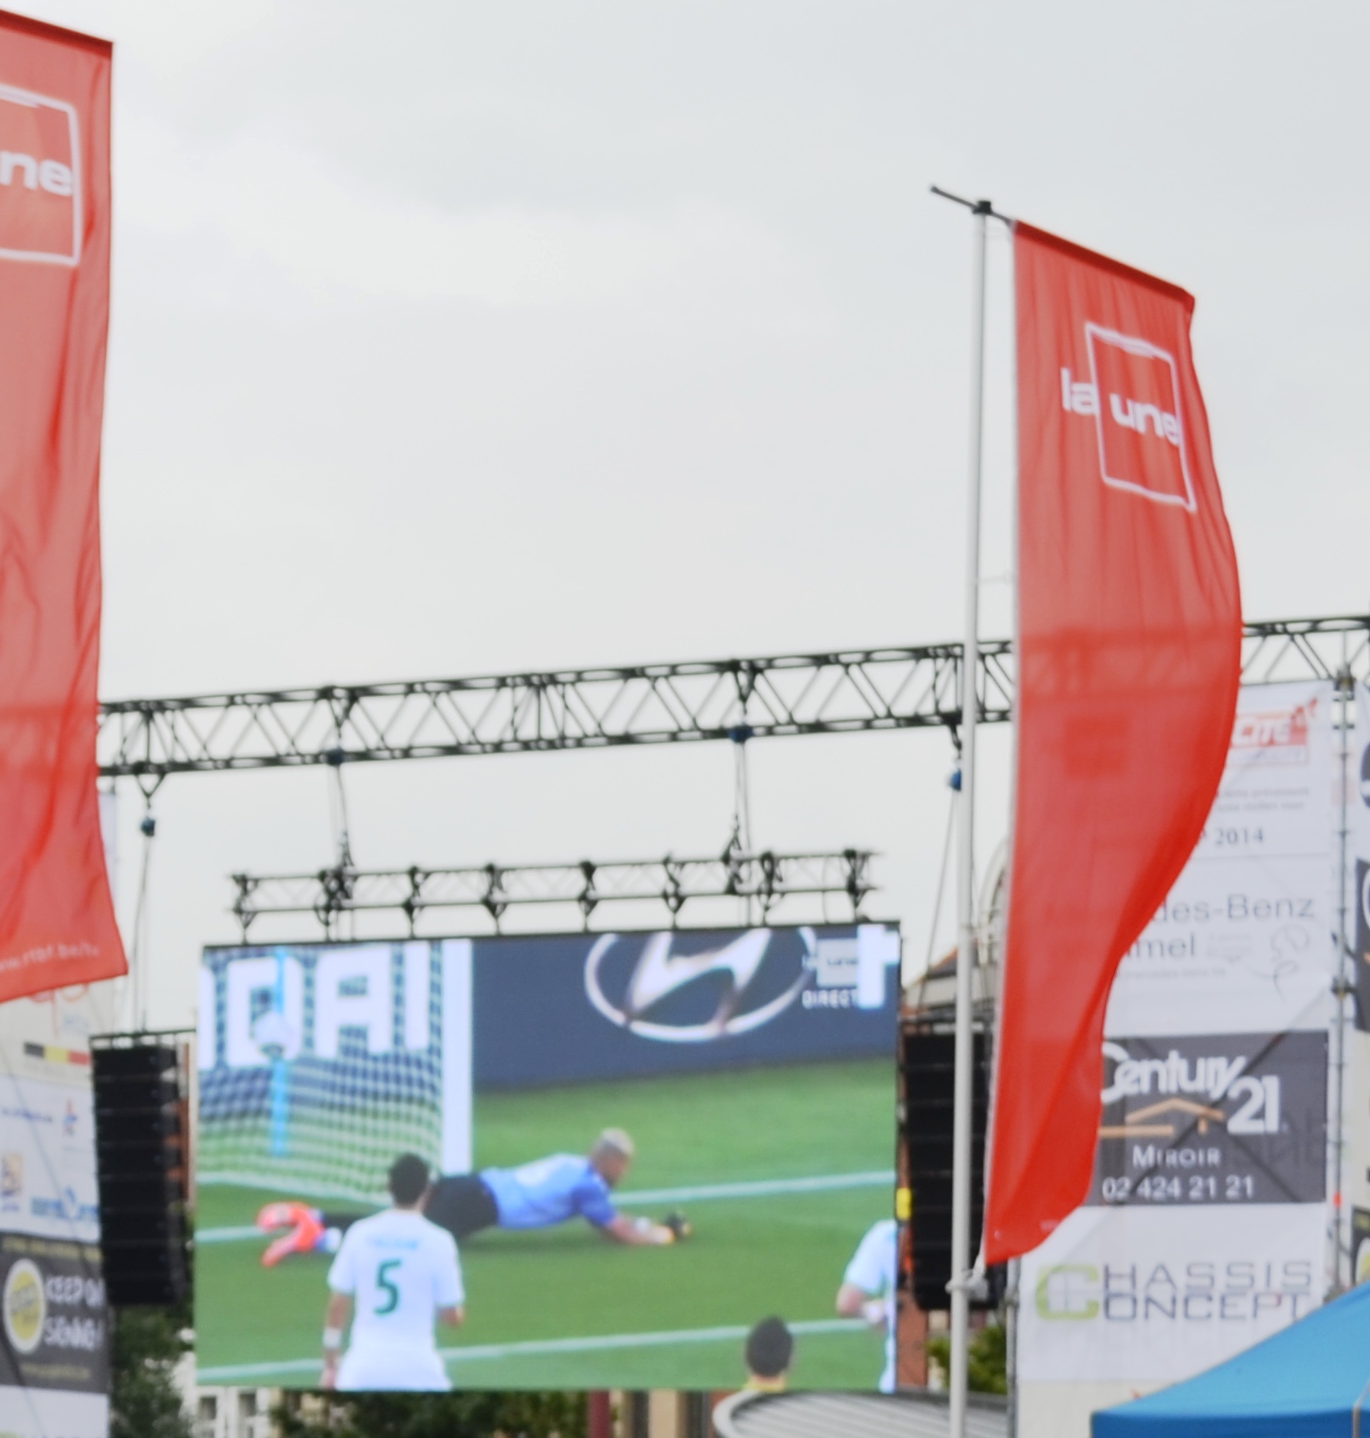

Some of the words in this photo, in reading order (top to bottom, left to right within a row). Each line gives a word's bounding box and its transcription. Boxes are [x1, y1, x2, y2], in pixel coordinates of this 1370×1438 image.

[1061, 366, 1098, 415] la
[1110, 393, 1181, 447] une
[1215, 827, 1265, 846] 2014
[1101, 1040, 1248, 1104] Century
[1226, 1075, 1281, 1134] 21
[1102, 1176, 1131, 1202] 02
[1136, 1176, 1182, 1200] 424
[1188, 1174, 1217, 1200] 21
[1226, 1174, 1254, 1200] 21
[374, 1258, 402, 1316] 5
